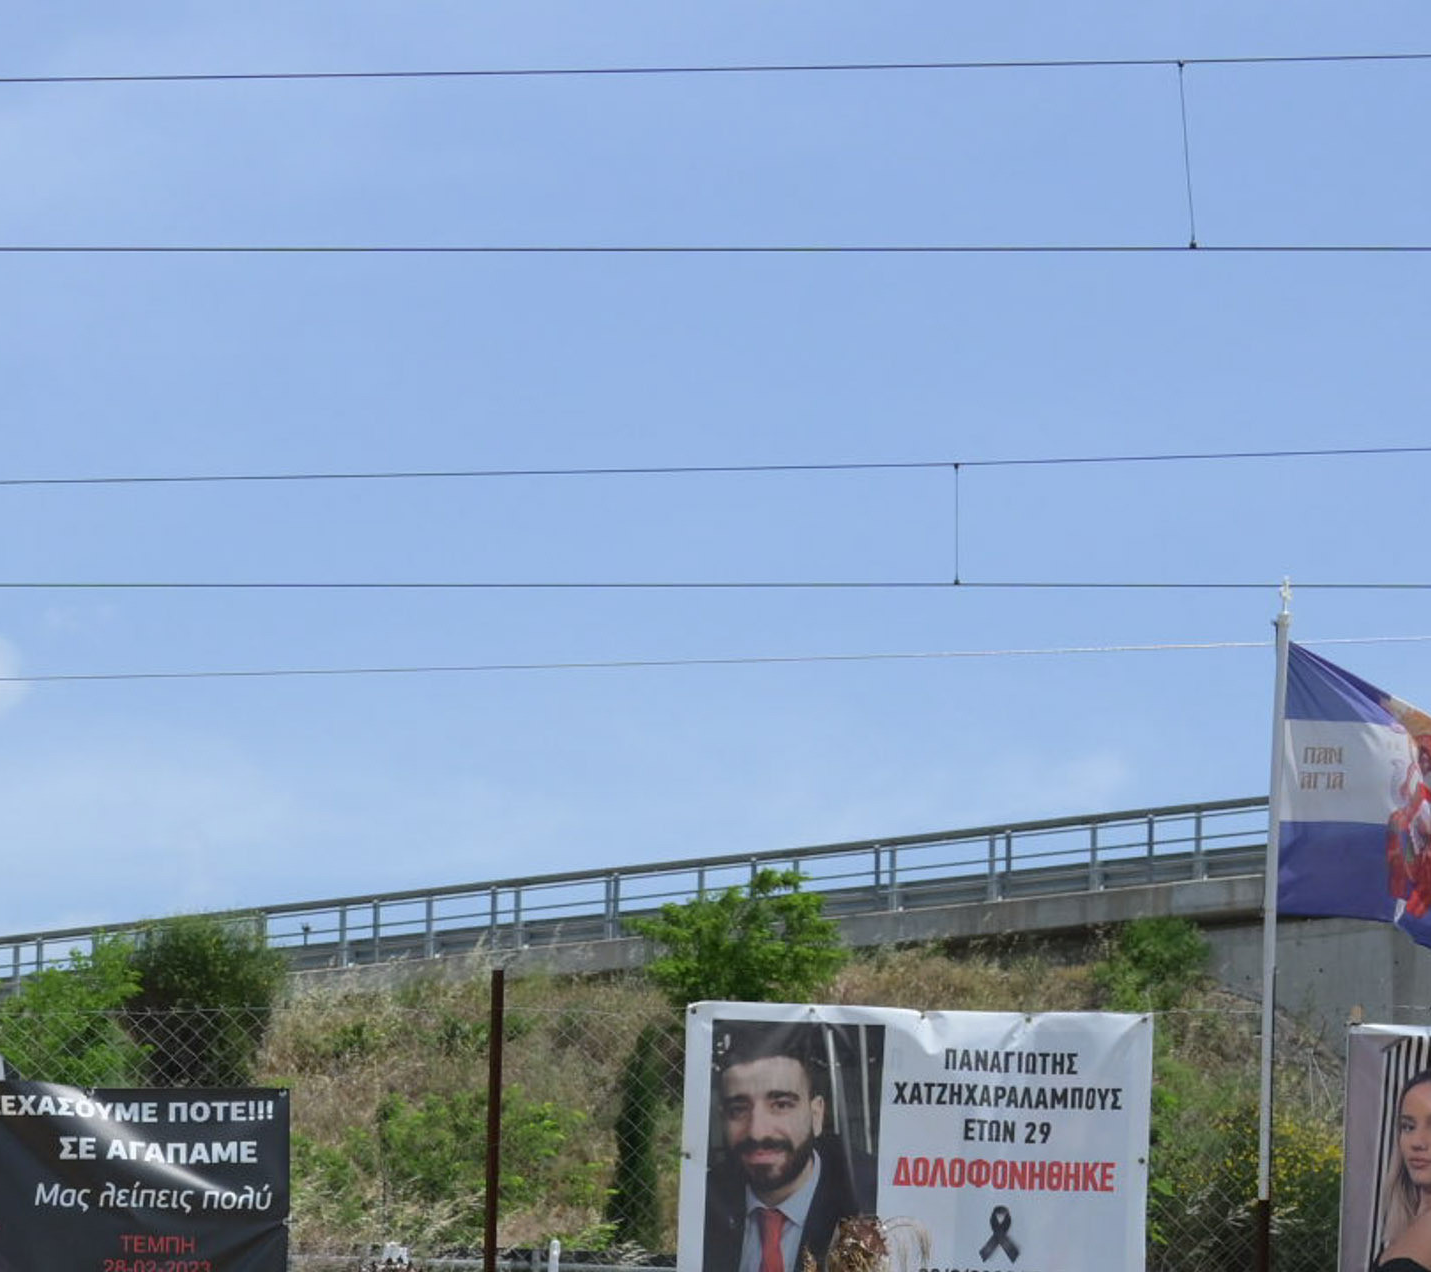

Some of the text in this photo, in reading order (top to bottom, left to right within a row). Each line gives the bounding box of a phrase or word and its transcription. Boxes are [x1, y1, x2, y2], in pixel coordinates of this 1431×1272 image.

[944, 1047, 1078, 1075] ΠΑΝΑΓΙΩΤΗΣ
[893, 1081, 1123, 1111] ΧΑΤΖΗΧΑΡΑΛΑΜΠΟΥΣ
[167, 1100, 275, 1124] ΠΟΤΕ!!!
[963, 1118, 1052, 1145] ΕΤΩΝ 29
[58, 1136, 259, 1165] ΣΕ ΑΓΑΠΑΜΕ
[892, 1156, 1116, 1193] ΔΟΛΟΦΟΝΗΘΗΚΕ
[34, 1180, 273, 1215] Μας λείπεις πολύ
[119, 1234, 197, 1255] ΤΕΜΠΗ
